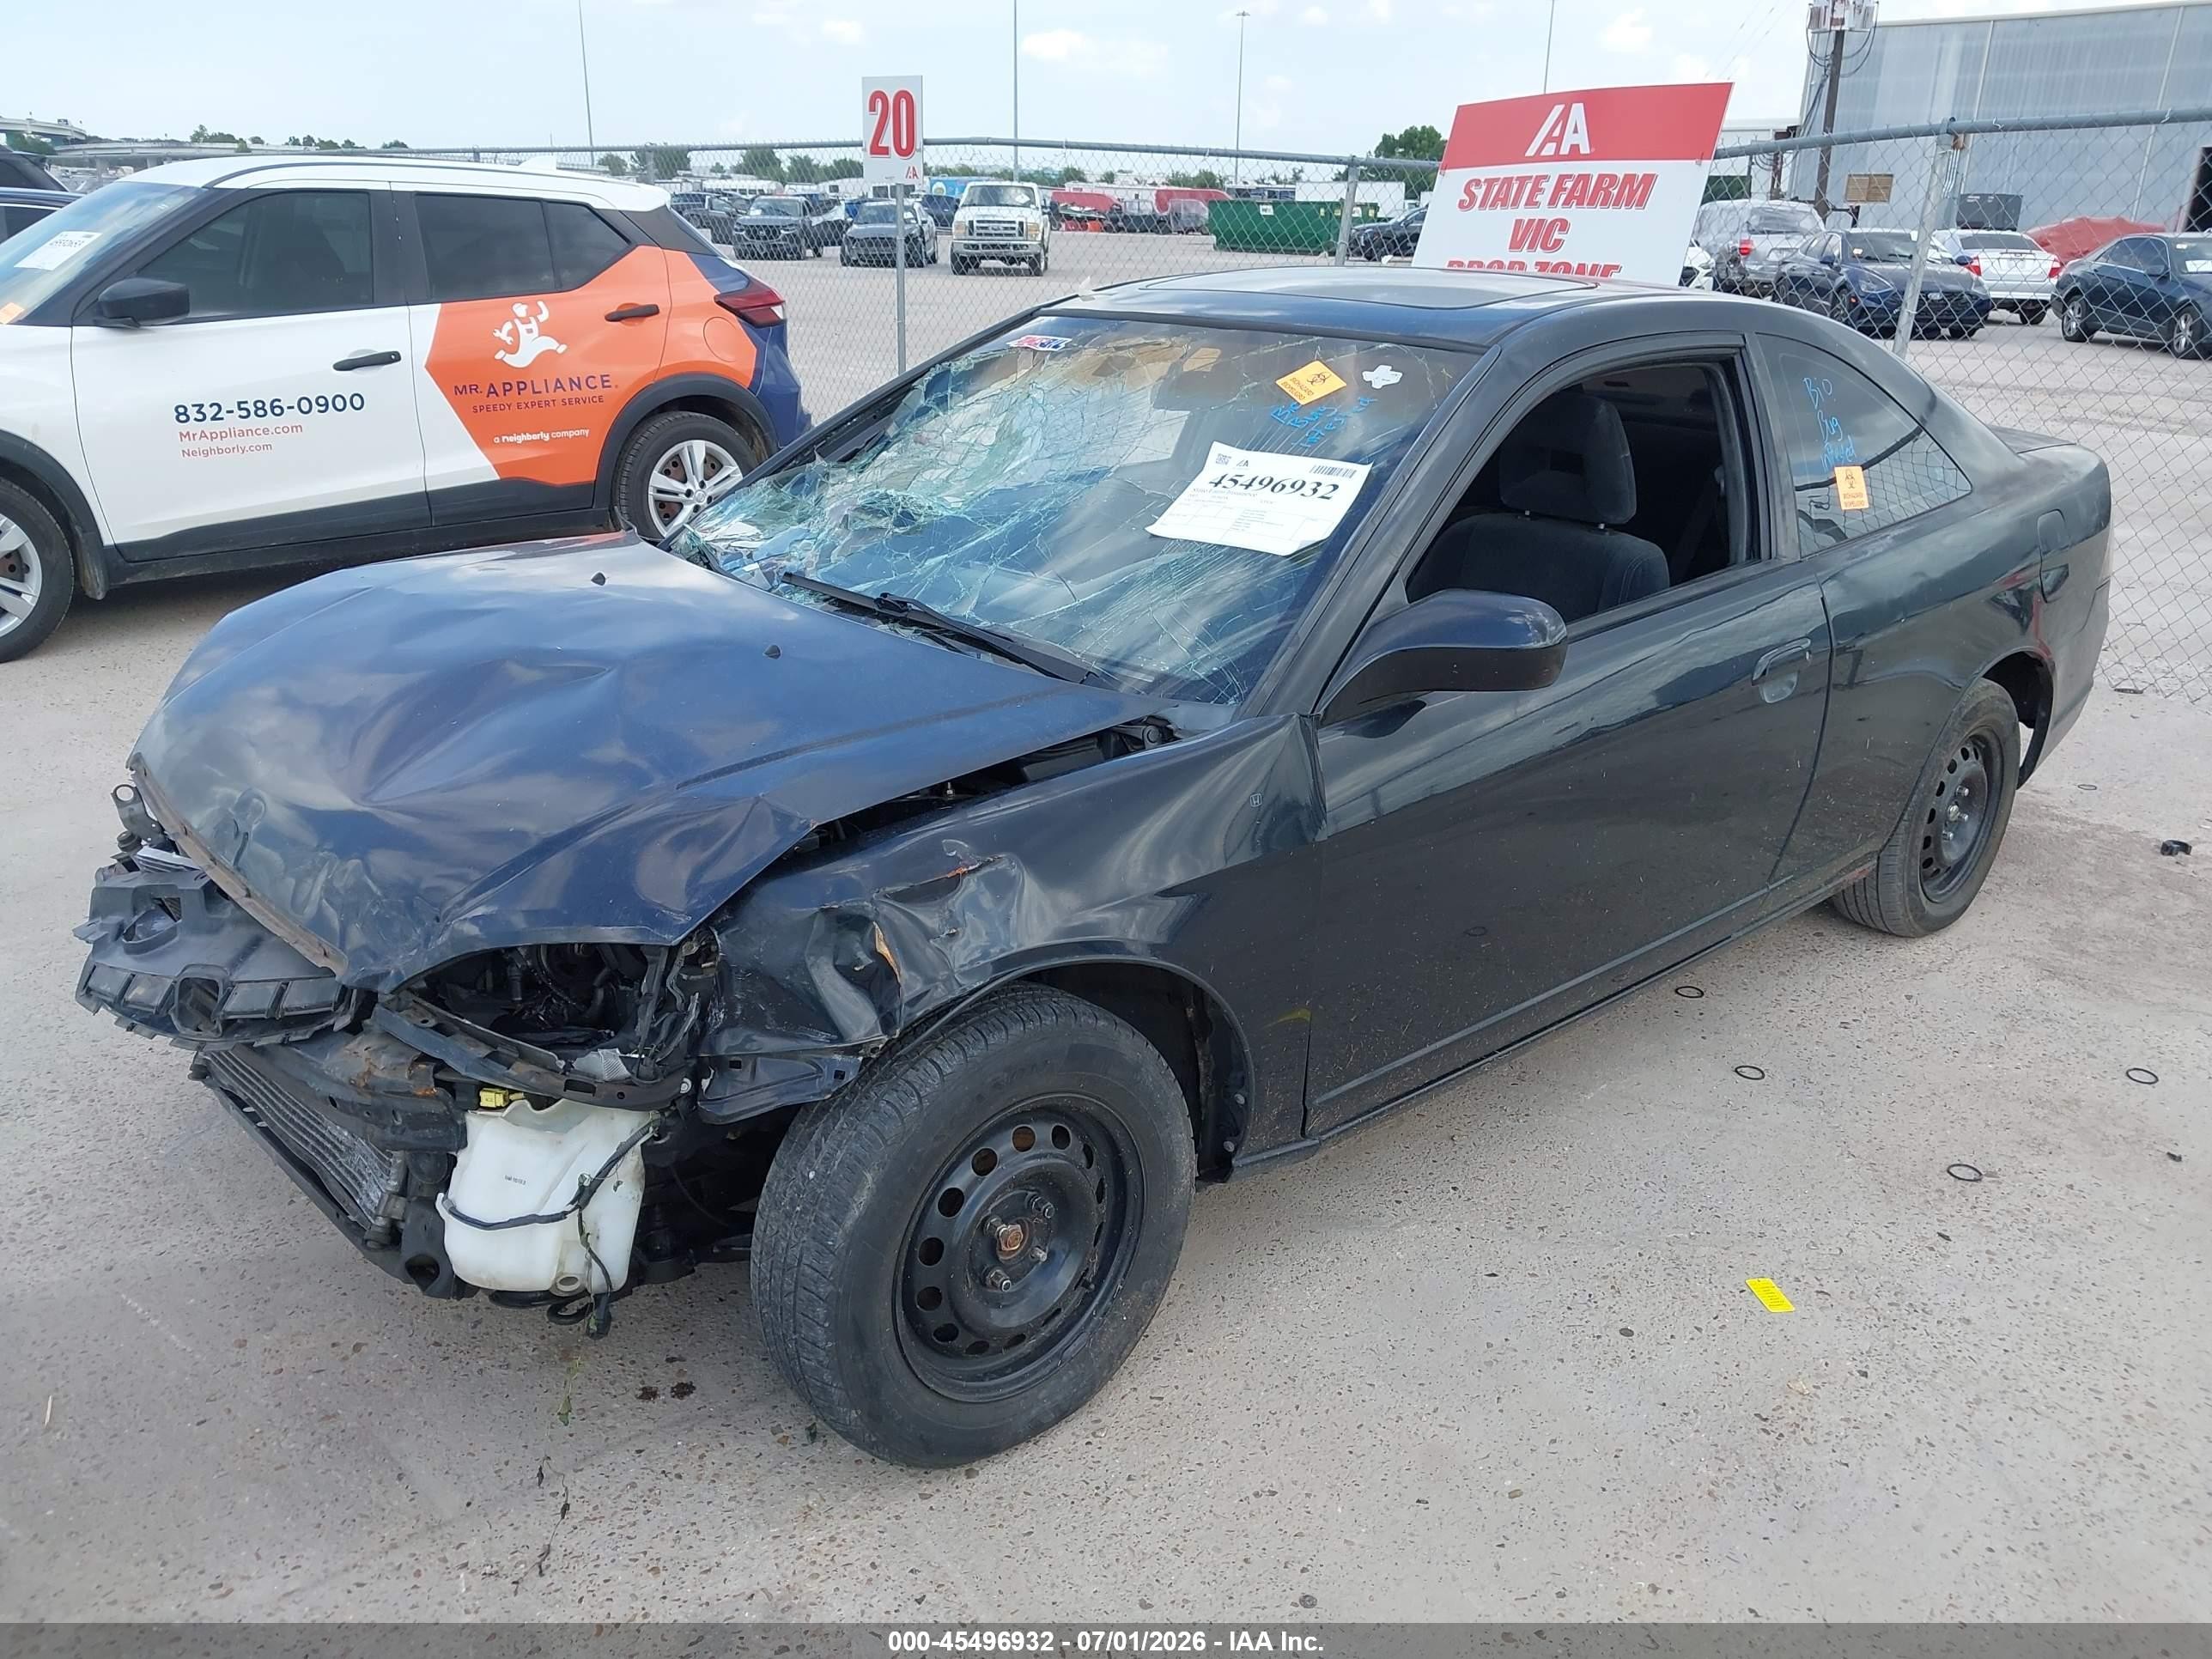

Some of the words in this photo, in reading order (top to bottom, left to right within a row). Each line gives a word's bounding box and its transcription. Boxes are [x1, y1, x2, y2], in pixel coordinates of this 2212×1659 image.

[868, 89, 916, 160] 20
[1458, 173, 1551, 214] STATE
[1547, 173, 1658, 211] FARM
[1508, 217, 1571, 253] VIC
[453, 383, 483, 396] MR.
[485, 374, 613, 398] APPLIANCE
[173, 392, 366, 424] 832-586-0900
[471, 402, 513, 414] SPEEDY
[516, 398, 557, 410] EXPERT
[561, 395, 605, 407] SERVICE
[178, 422, 304, 443] MrAppliance.com
[550, 428, 590, 439] company
[181, 441, 273, 459] Neighborly.com
[1208, 472, 1340, 501] 45496932
